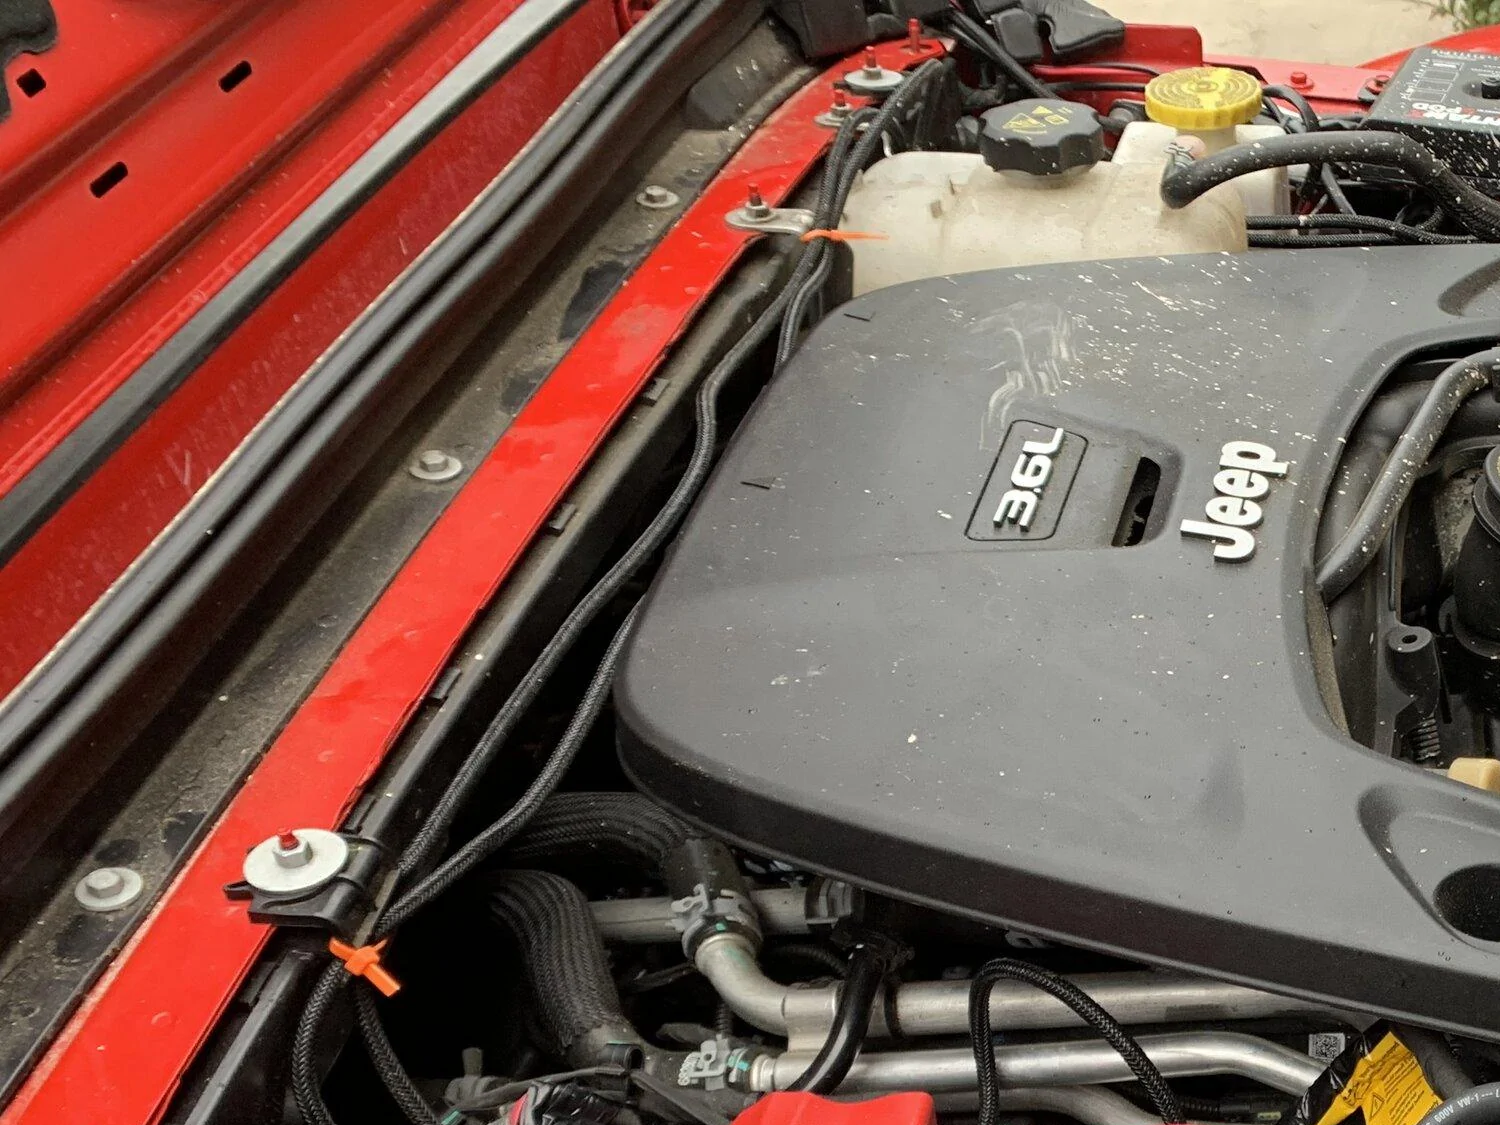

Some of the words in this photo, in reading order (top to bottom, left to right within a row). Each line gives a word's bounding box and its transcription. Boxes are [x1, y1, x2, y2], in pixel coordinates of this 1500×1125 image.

[993, 427, 1064, 533] 3.6L
[1180, 441, 1289, 562] Jeep
[1435, 1104, 1455, 1123] 600V
